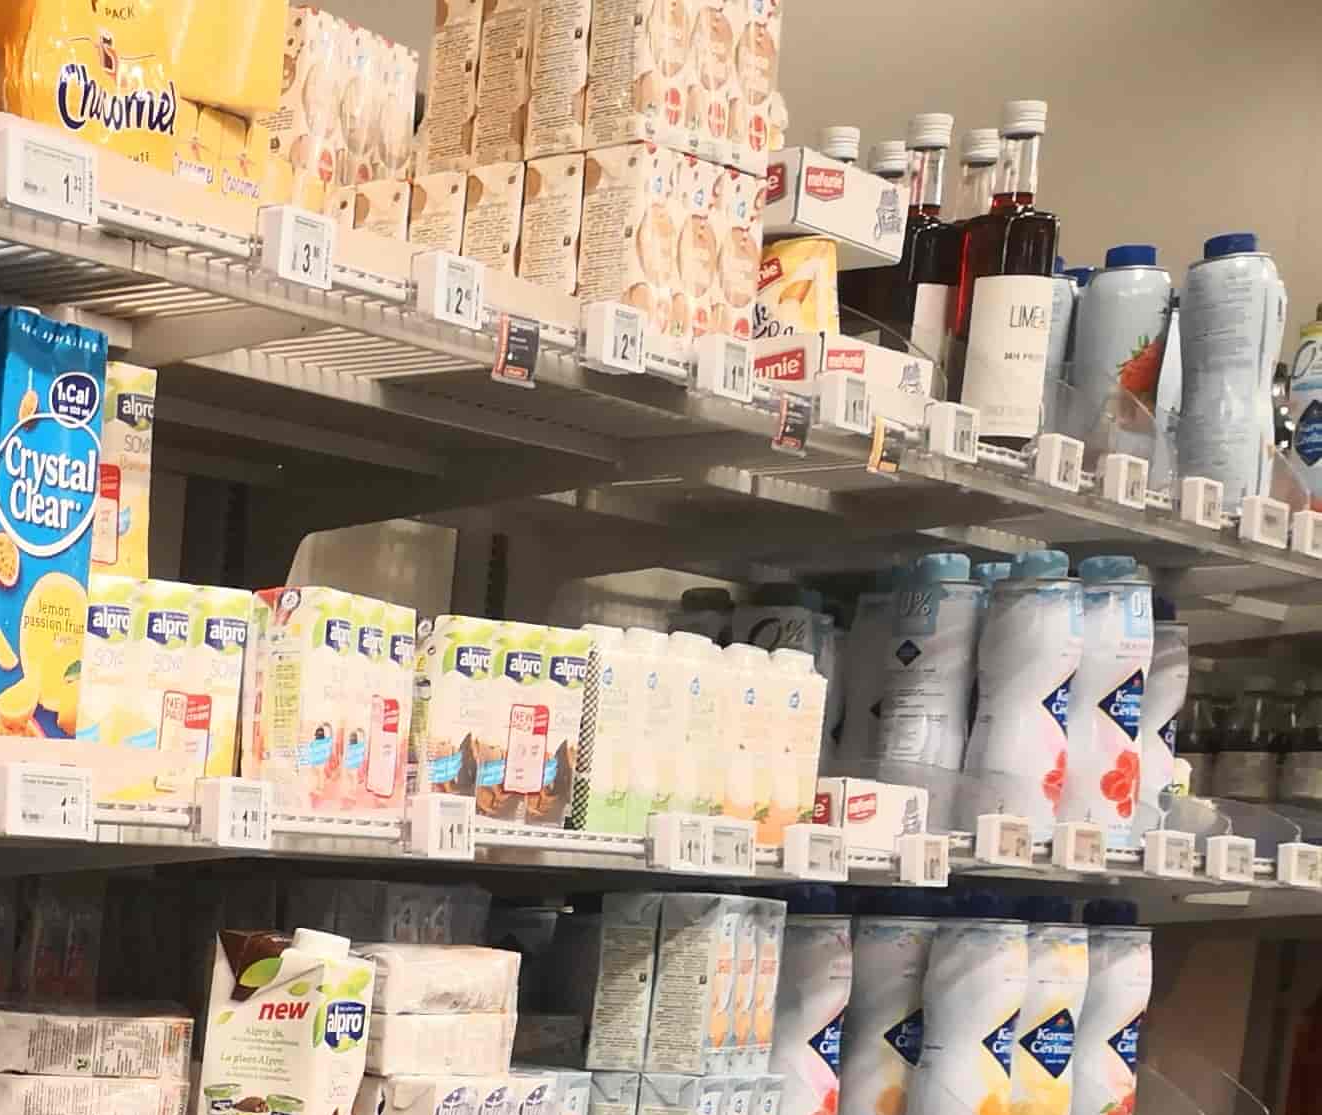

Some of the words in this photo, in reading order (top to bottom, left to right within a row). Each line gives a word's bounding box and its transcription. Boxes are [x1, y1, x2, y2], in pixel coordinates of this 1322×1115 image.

[105, 7, 134, 20] PACK
[4, 436, 96, 493] Crystal
[9, 480, 74, 529] Clear
[37, 599, 72, 617] lemon
[23, 613, 61, 631] passion
[152, 618, 188, 641] alpro
[209, 622, 245, 645] alpro
[510, 654, 542, 676] alpro
[555, 659, 587, 679] alpro
[259, 1000, 311, 1020] new
[326, 1005, 363, 1040] alpro
